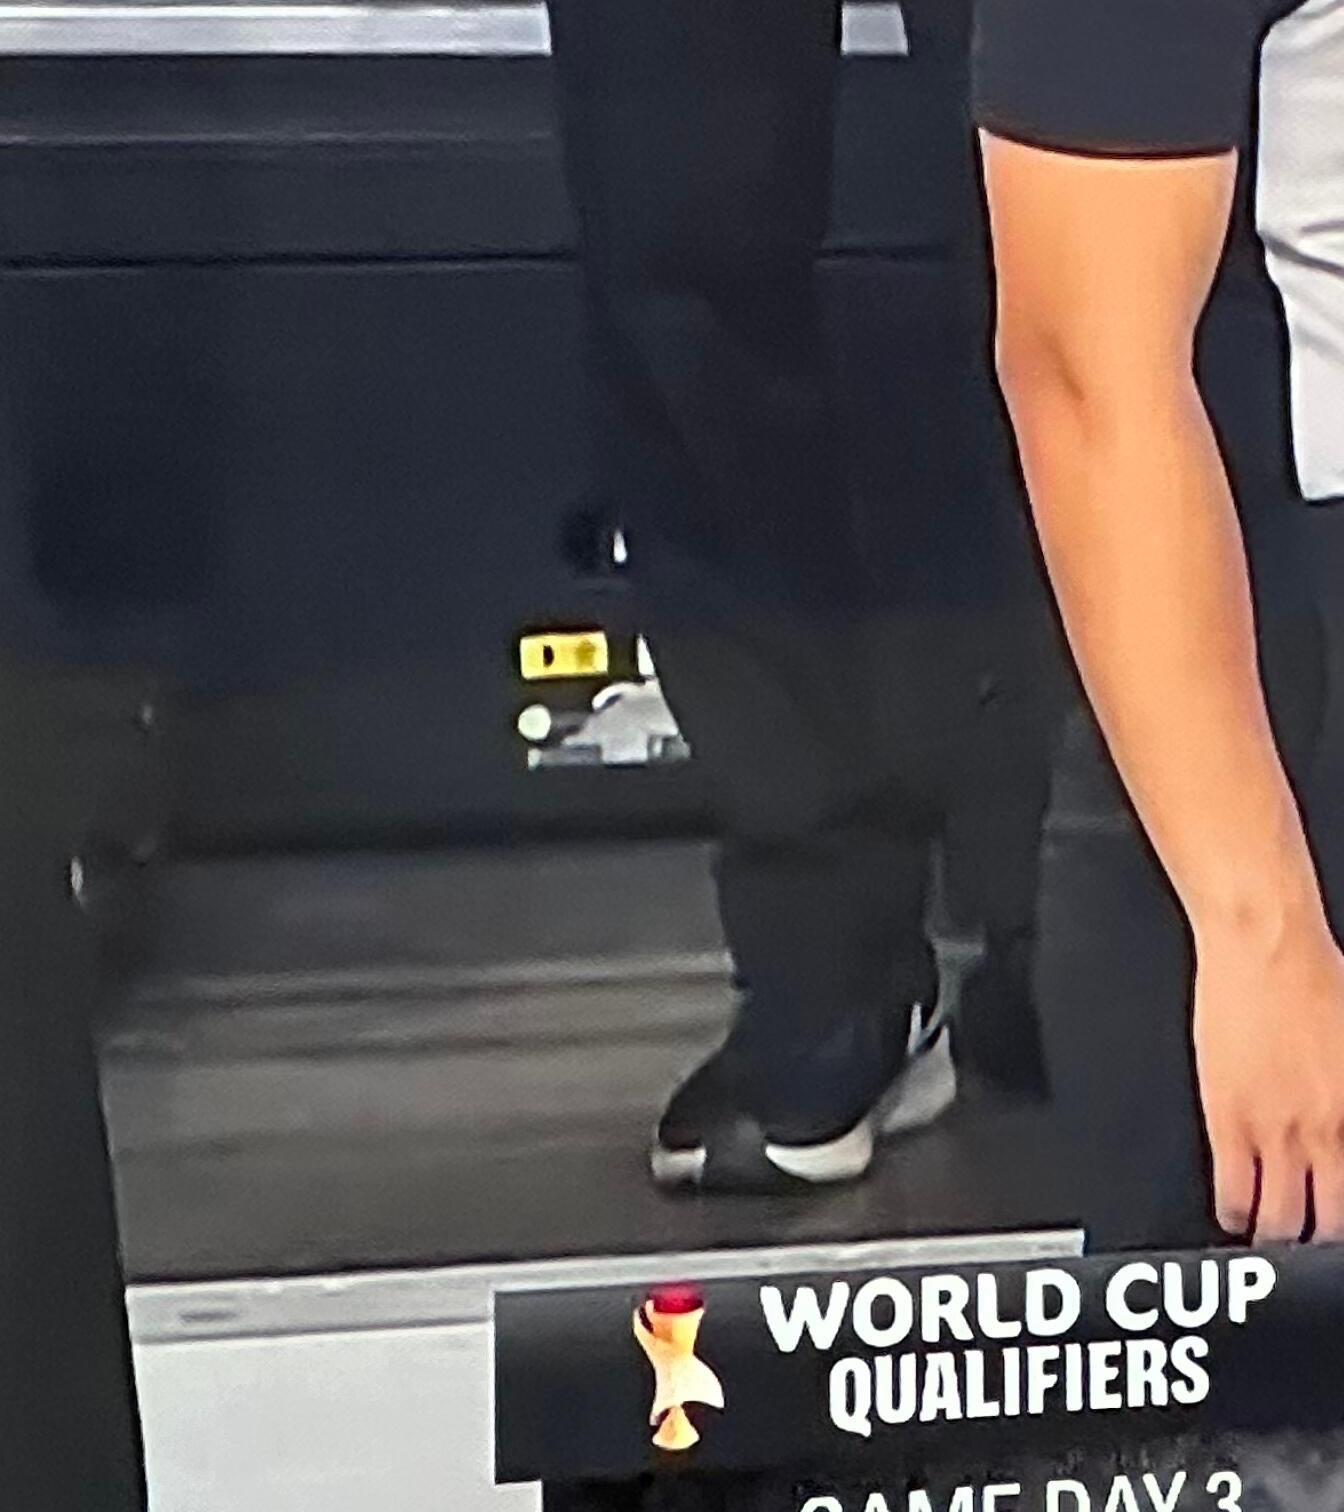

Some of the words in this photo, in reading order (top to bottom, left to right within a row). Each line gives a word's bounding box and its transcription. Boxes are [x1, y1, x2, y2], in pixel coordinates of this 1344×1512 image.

[758, 1267, 1082, 1354] WORLD
[1104, 1255, 1278, 1332] CUP
[828, 1334, 1212, 1439] QUALIFIERS
